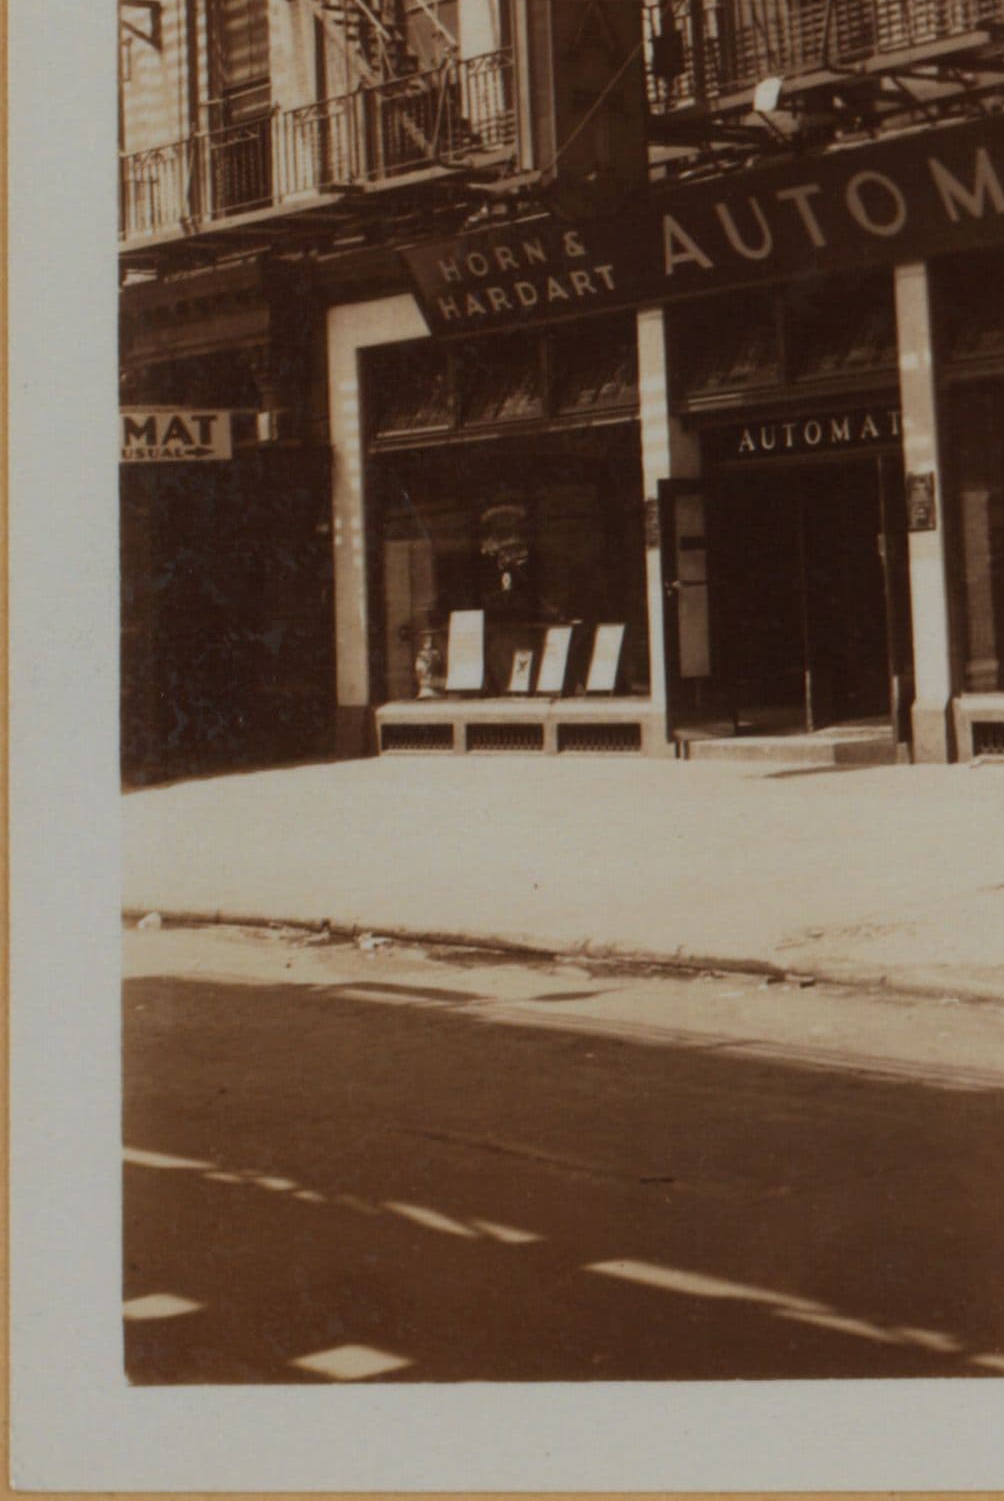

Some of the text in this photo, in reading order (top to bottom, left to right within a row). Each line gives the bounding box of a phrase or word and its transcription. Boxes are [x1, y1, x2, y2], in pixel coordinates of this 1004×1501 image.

[438, 230, 586, 282] HORN &
[438, 264, 616, 320] HARDART
[122, 414, 218, 446] MAT
[738, 410, 900, 453] AUTOMAT
[122, 447, 186, 460] USUAL
